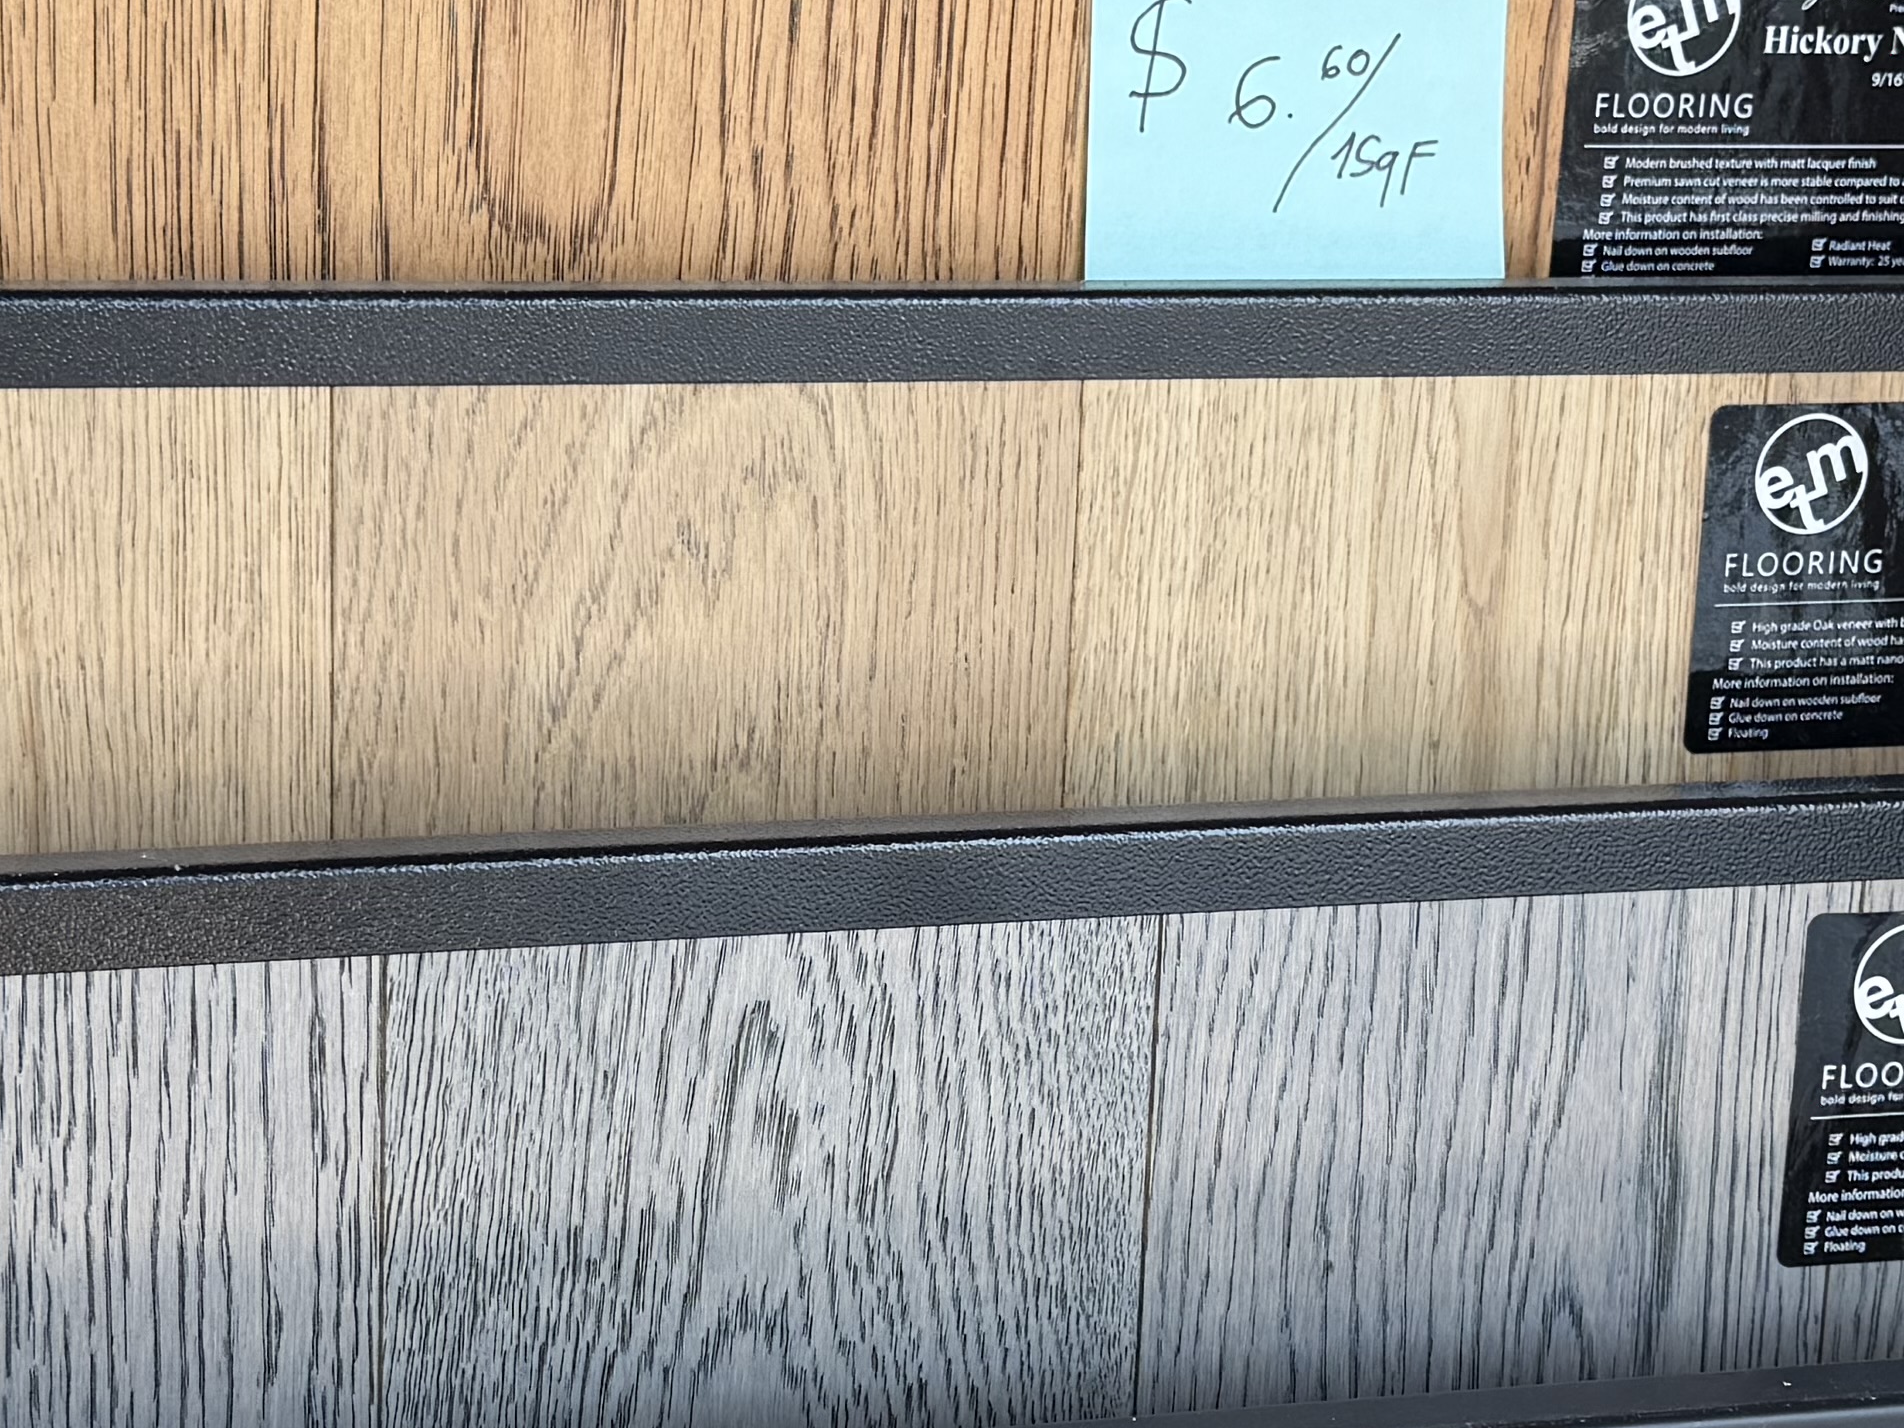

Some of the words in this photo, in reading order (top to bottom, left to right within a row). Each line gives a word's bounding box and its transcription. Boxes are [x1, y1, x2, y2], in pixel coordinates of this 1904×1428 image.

[1762, 24, 1884, 63] Hickory
[1594, 91, 1754, 119] FLOORING
[1581, 228, 1613, 241] More
[1613, 227, 1681, 241] information
[1681, 230, 1697, 240] on
[1698, 227, 1763, 240] installation:
[1723, 548, 1883, 578] FLOORING
